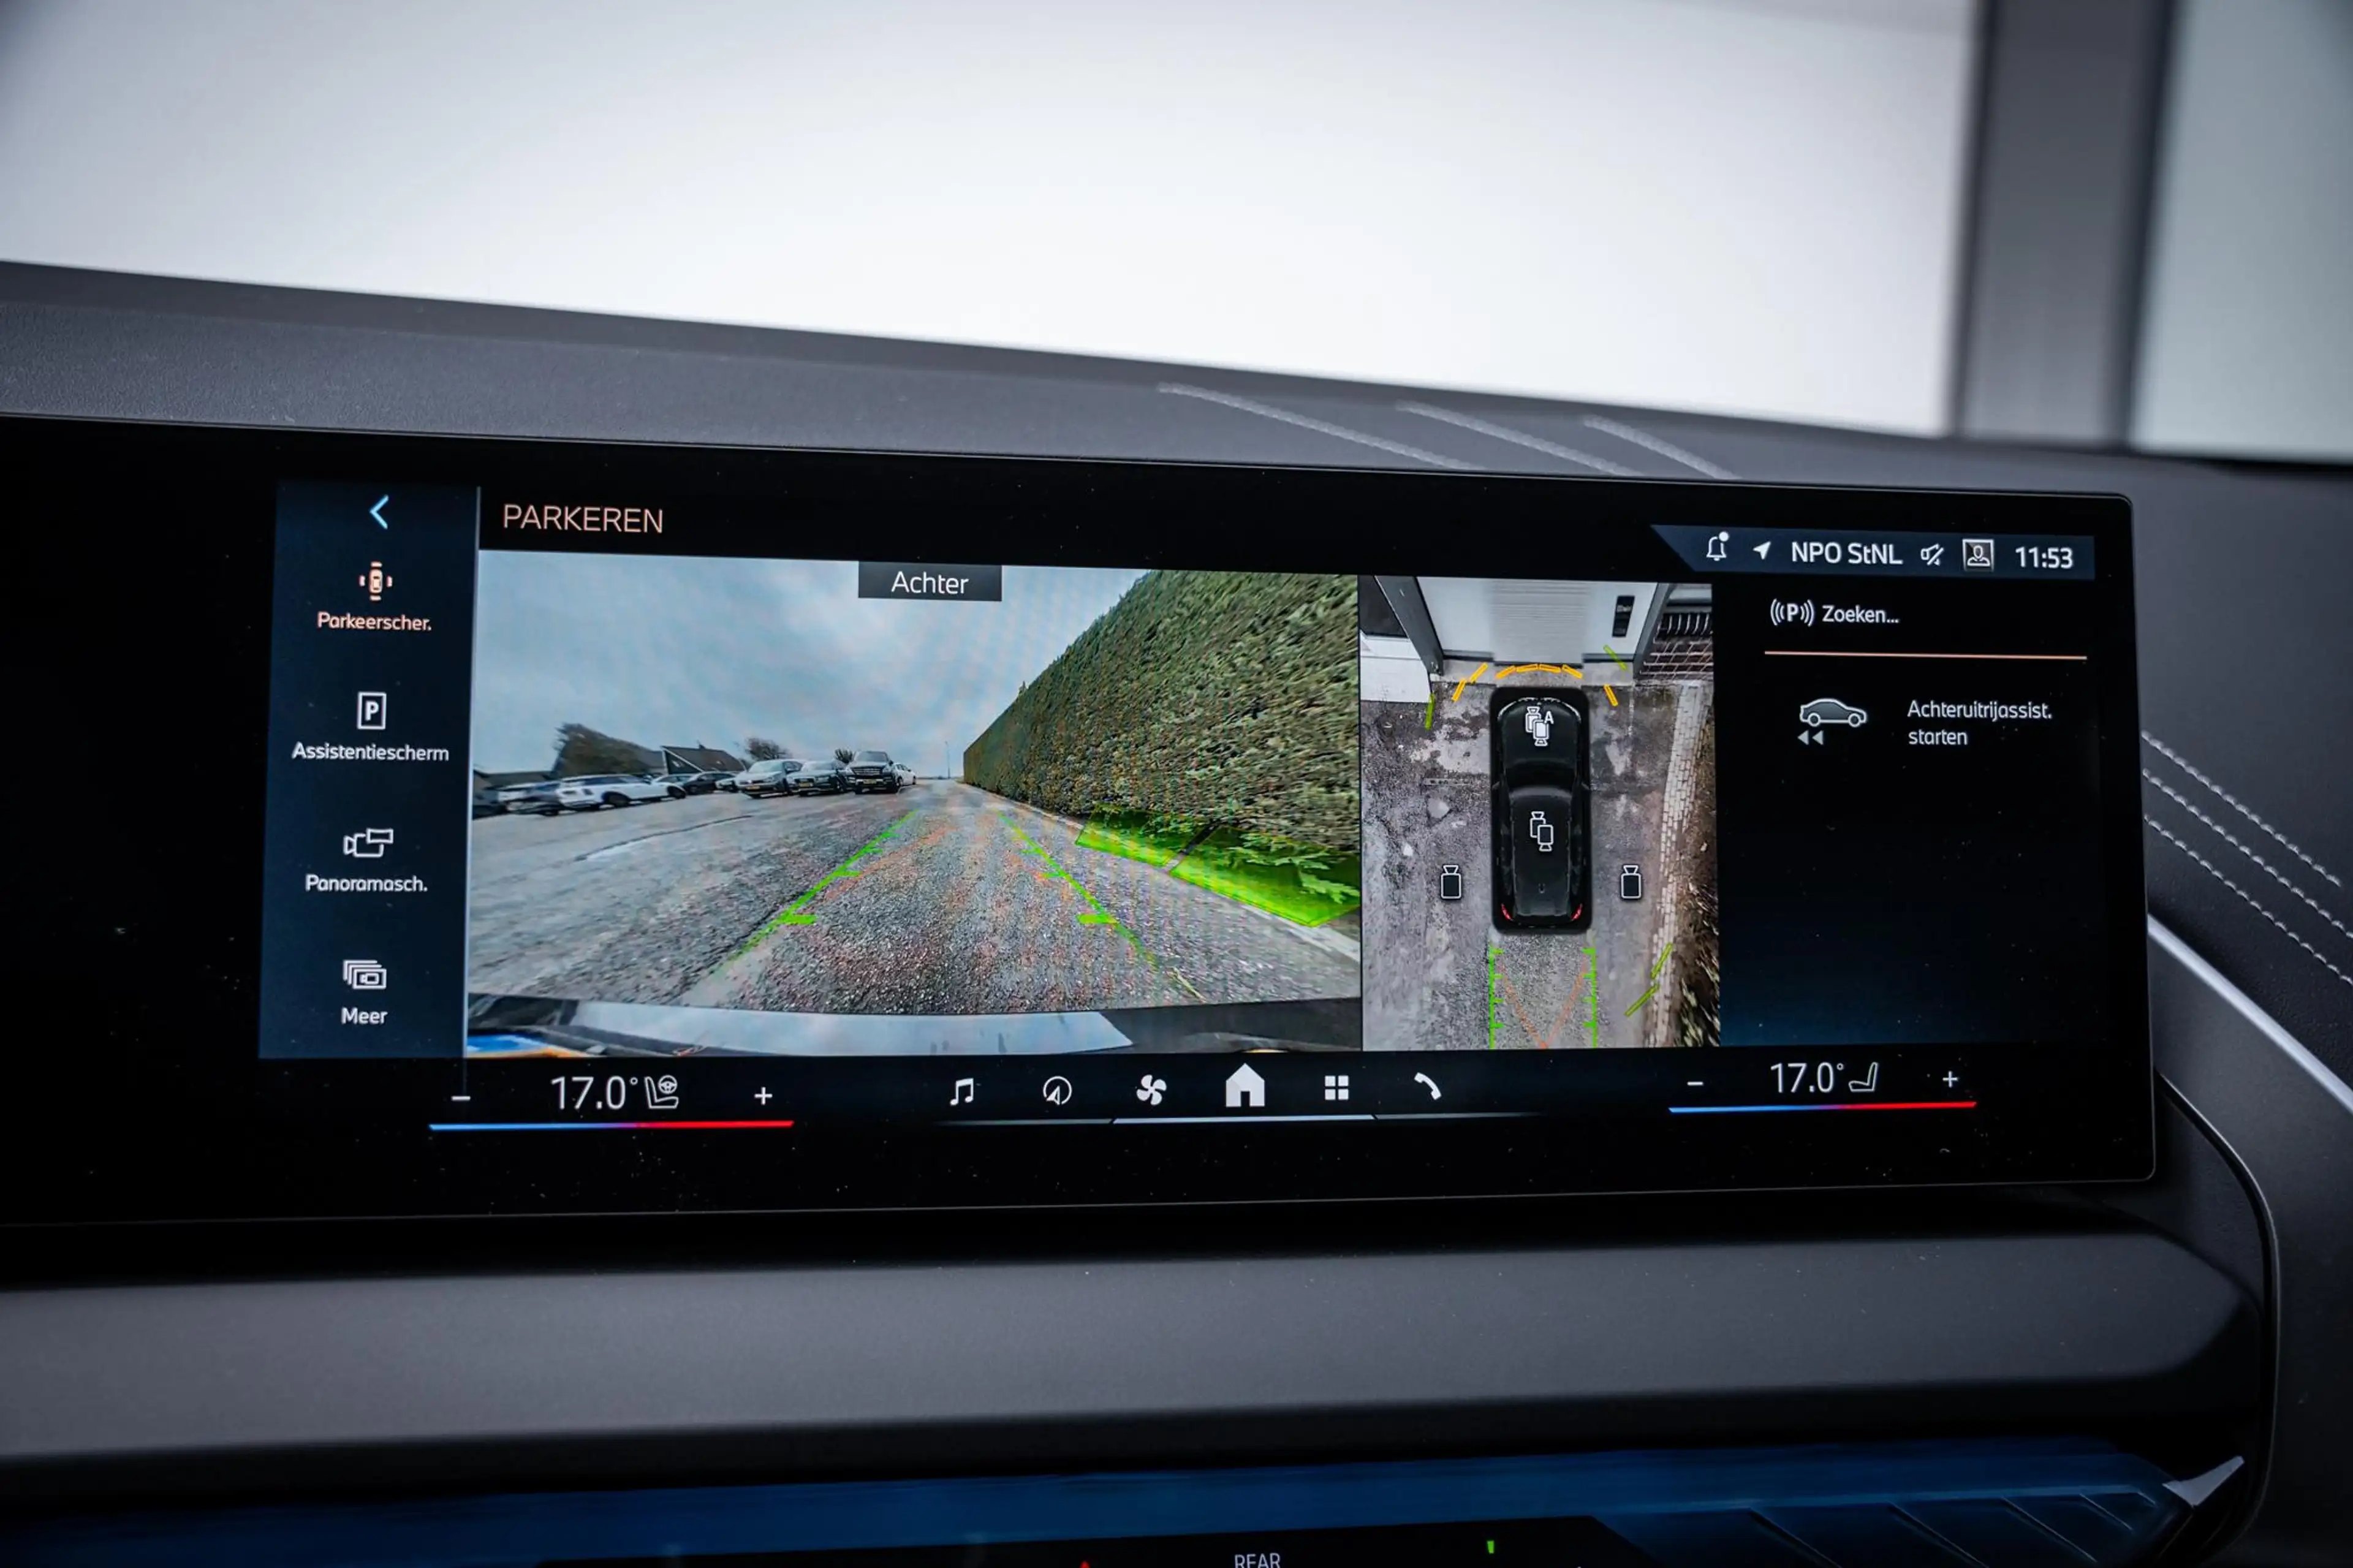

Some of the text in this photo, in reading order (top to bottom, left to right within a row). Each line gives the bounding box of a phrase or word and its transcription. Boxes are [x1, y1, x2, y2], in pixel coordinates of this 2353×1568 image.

[503, 504, 664, 534] PARKEREN
[1791, 541, 1904, 565] NPO StNL
[2015, 545, 2074, 569] 11:53
[890, 570, 969, 596] Achter
[317, 611, 432, 631] Parkeerscher.
[1822, 604, 1900, 624] Zoeken...
[1906, 699, 2052, 722] Achteruitrijassist.
[1908, 729, 1968, 746] starten
[291, 741, 450, 761] Assistentiescherm
[305, 873, 428, 892] Panoramasch.
[341, 1007, 388, 1025] Meer
